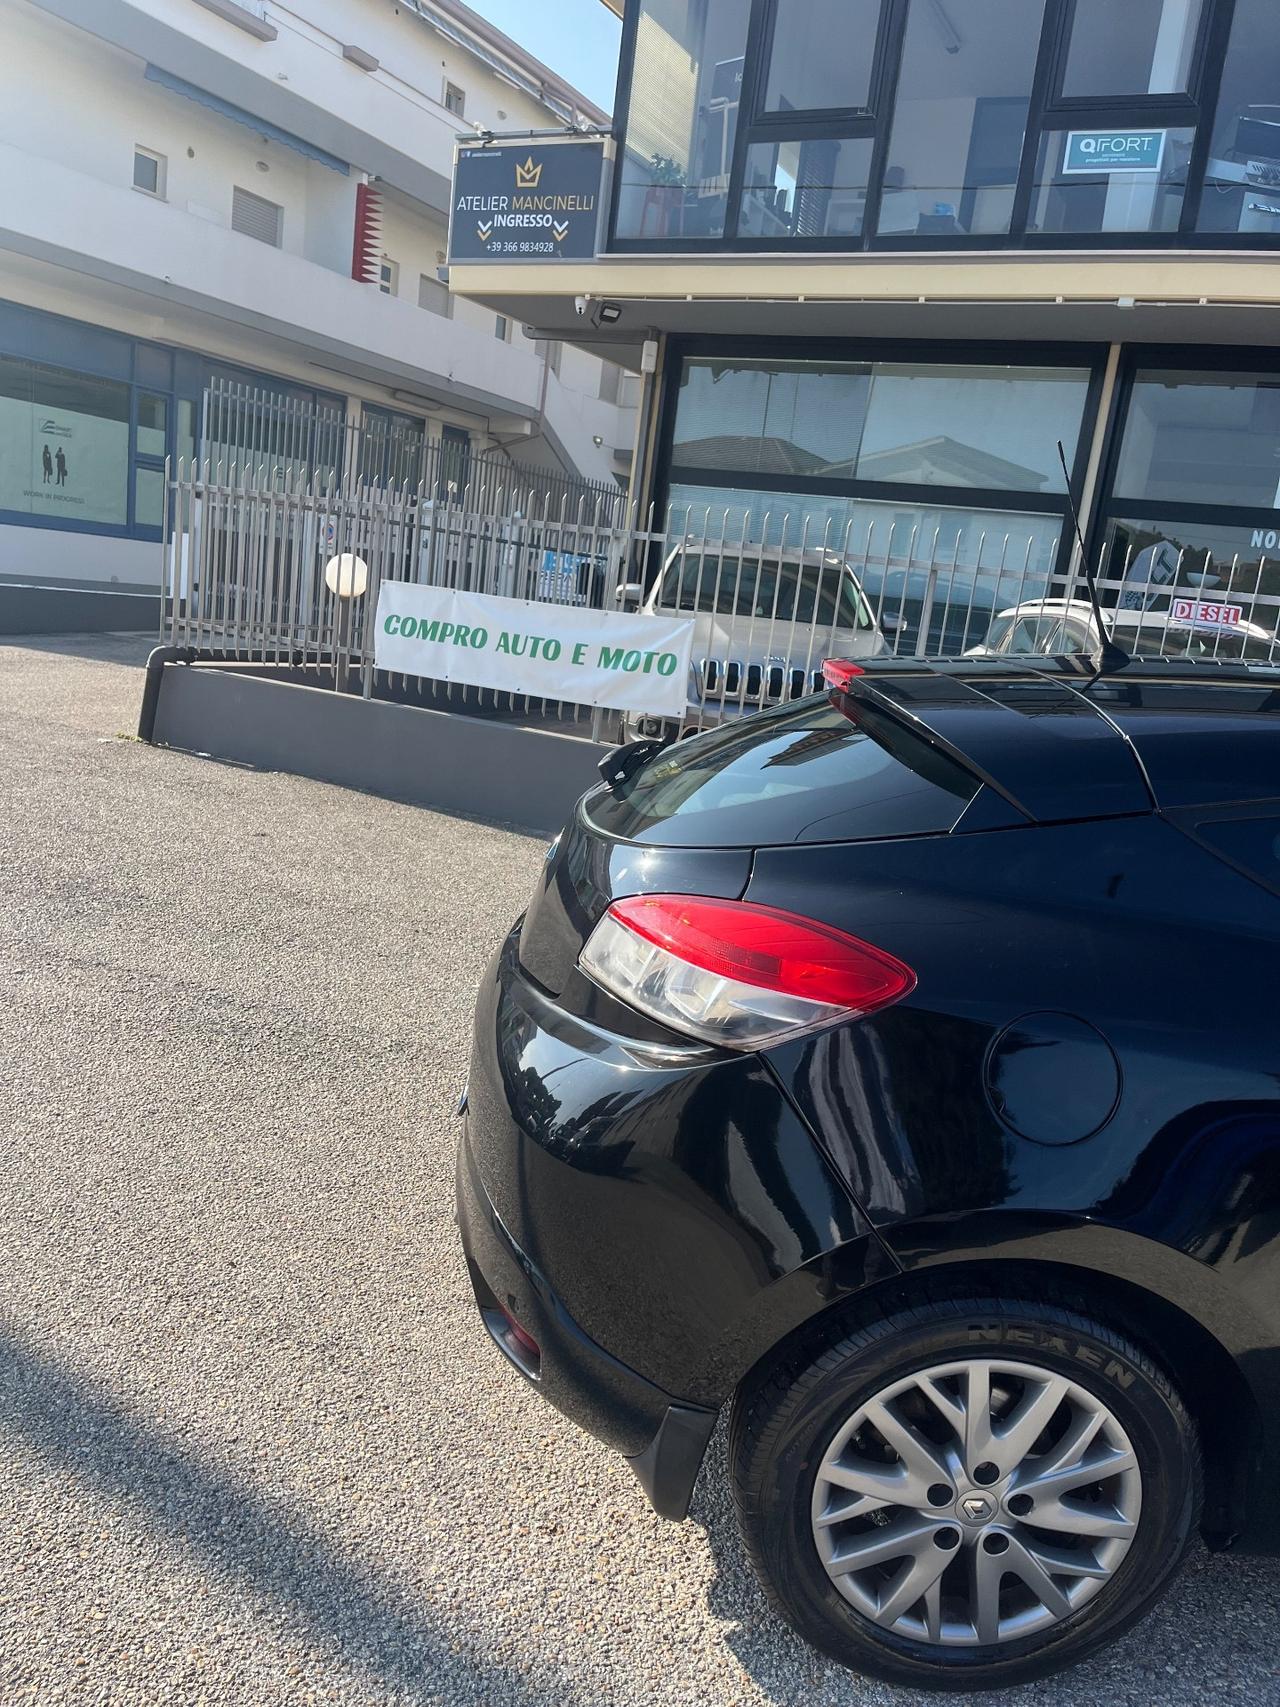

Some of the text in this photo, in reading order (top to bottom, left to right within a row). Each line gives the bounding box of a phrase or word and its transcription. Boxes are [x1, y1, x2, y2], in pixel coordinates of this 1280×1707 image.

[1080, 138, 1152, 153] QFORT
[457, 195, 594, 211] ATELIER MANCINELLI
[493, 214, 553, 228] INGRESSO
[486, 242, 554, 252] +39 366 9834928
[1175, 602, 1237, 624] DIESEL
[383, 614, 678, 677] COMPRO AUTO E MOTO
[967, 1324, 1136, 1389] NEXEN
